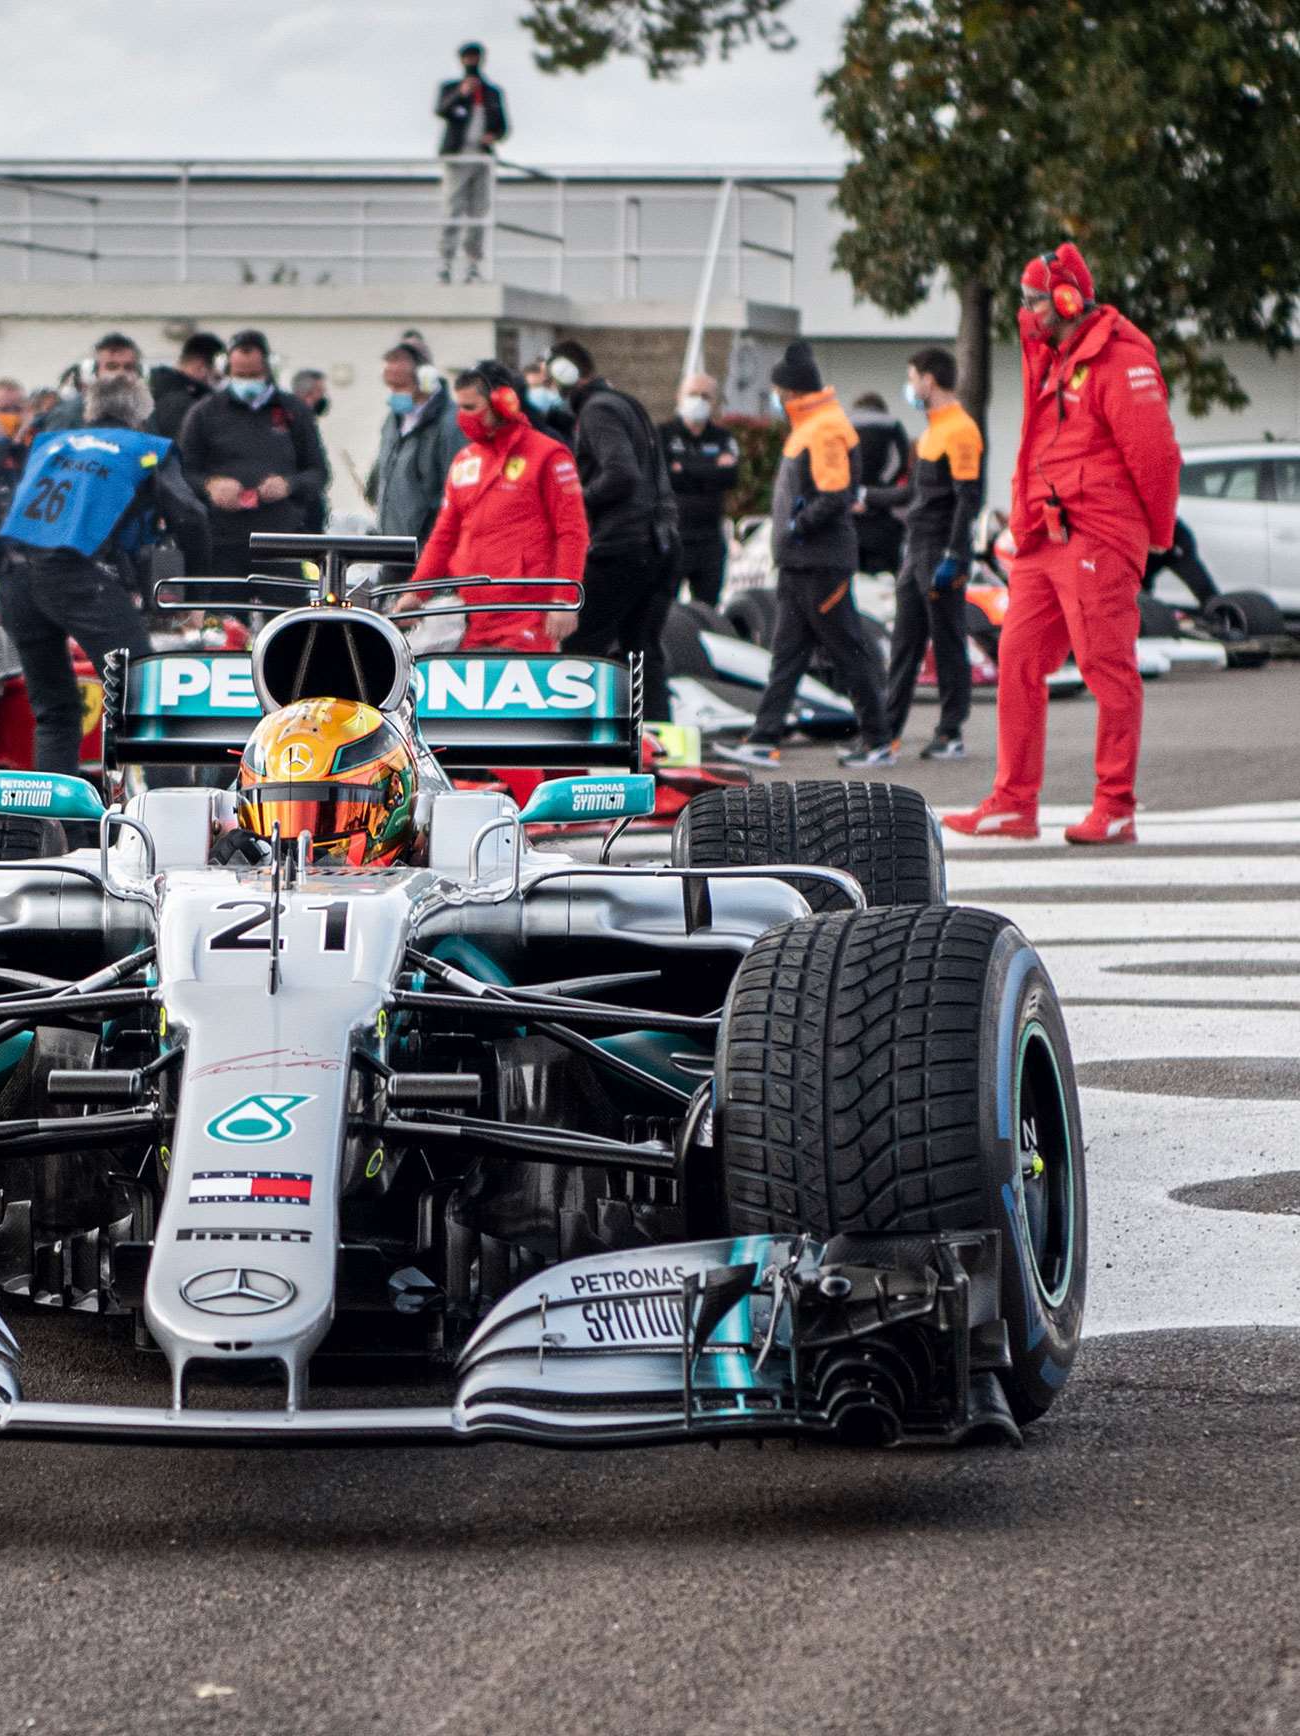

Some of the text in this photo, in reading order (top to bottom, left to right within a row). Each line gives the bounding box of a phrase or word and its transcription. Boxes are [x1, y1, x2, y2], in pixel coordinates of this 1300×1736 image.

[24, 475, 73, 524] 26
[160, 659, 597, 710] PENAS
[0, 779, 53, 789] PETRONAS
[571, 783, 625, 793] PETRONAS
[1, 789, 53, 807] SYNTIUM
[572, 793, 626, 811] SYNTIUM
[207, 897, 353, 953] 21
[203, 1170, 304, 1181] TOMMY
[197, 1194, 301, 1204] HILFIGER
[570, 1265, 685, 1295] PETRONAS
